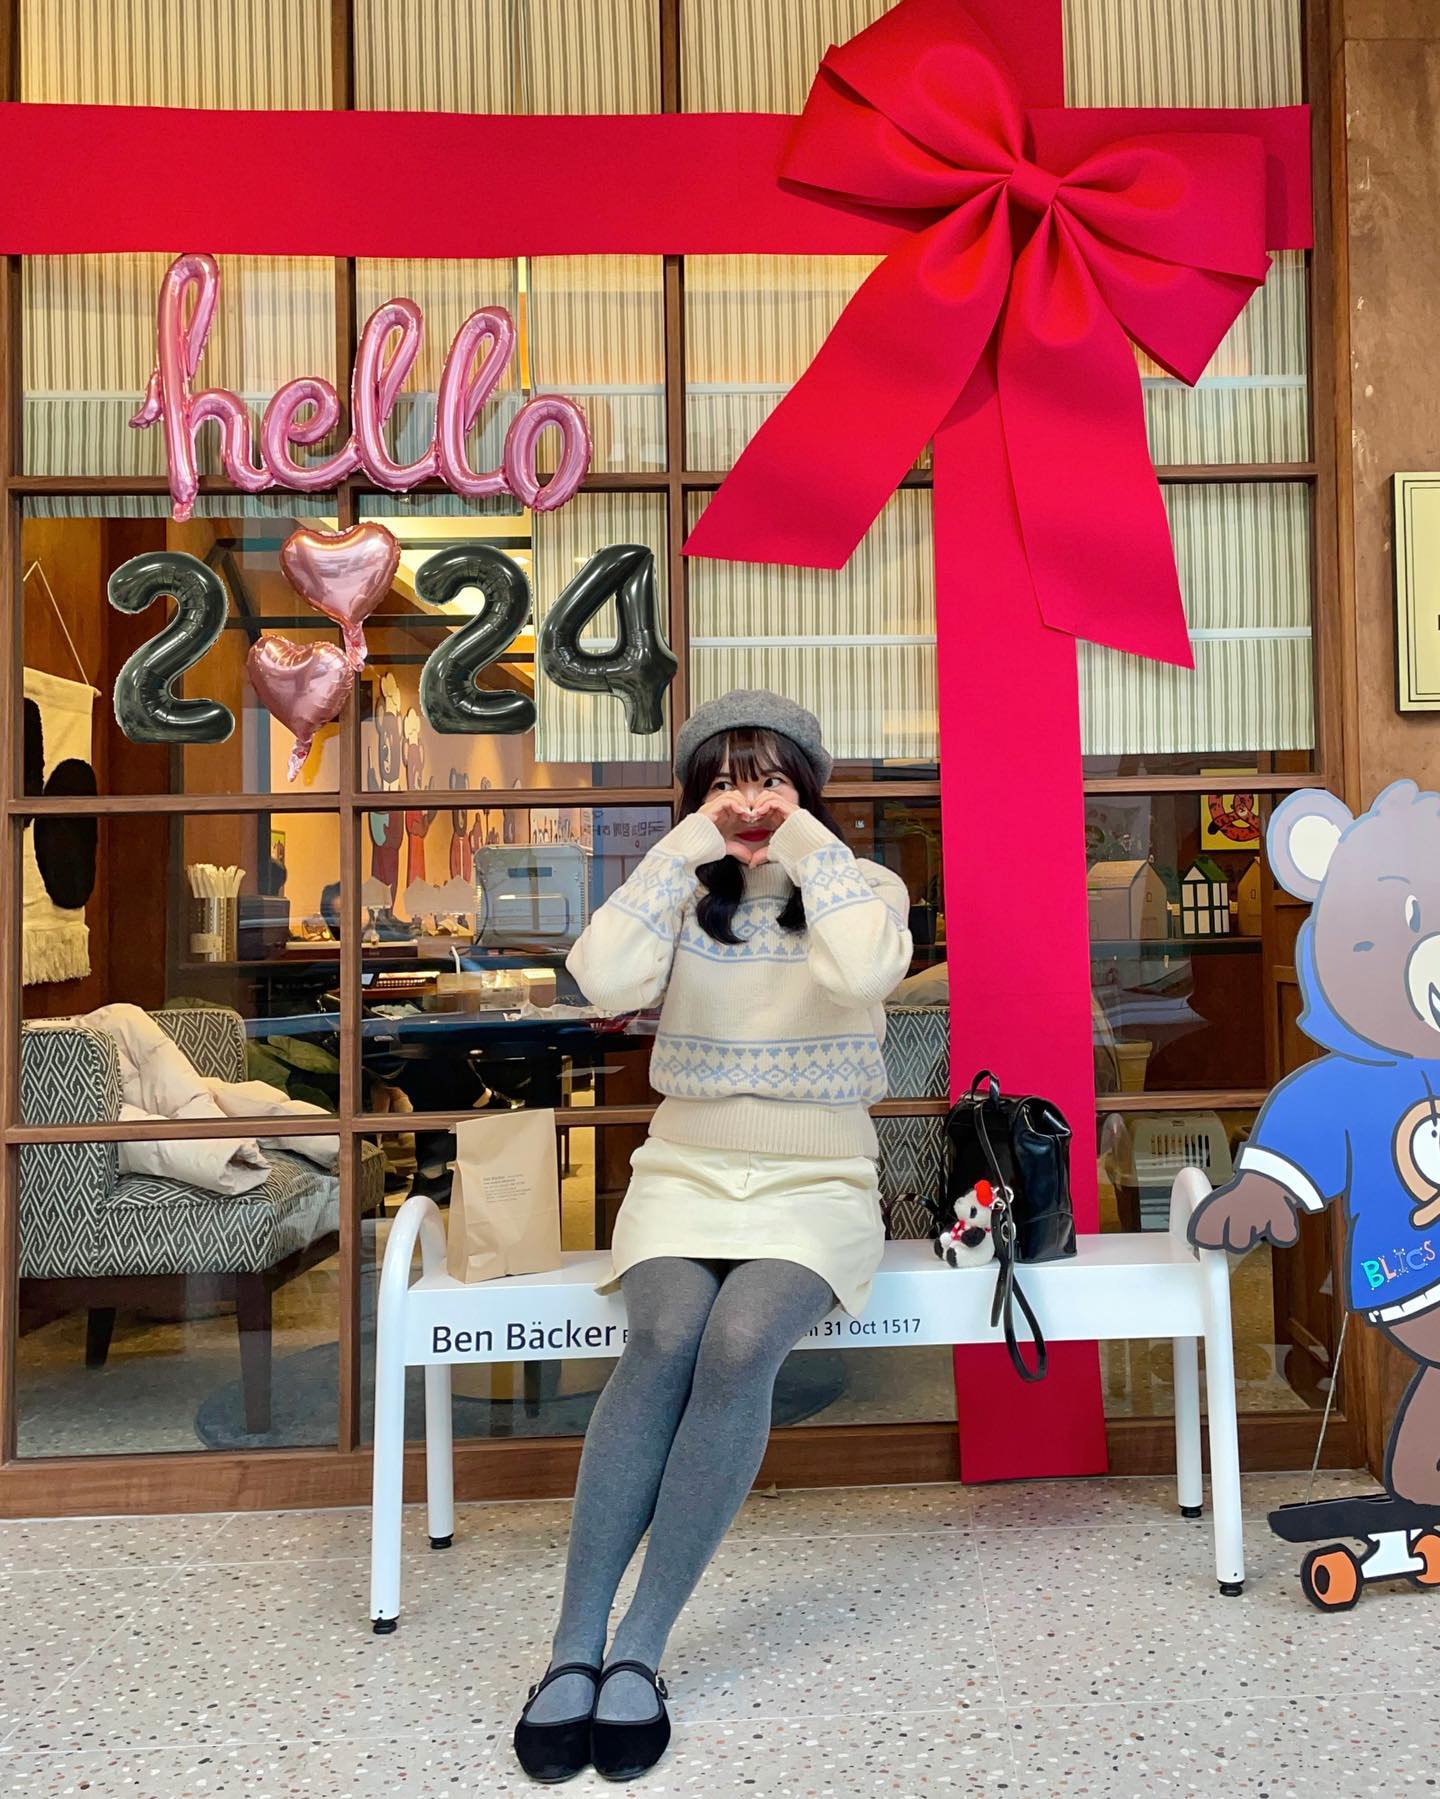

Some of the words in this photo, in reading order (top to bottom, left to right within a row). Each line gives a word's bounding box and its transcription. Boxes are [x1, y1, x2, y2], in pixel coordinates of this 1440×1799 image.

[129, 252, 593, 522] hello
[1360, 1240, 1436, 1291] BLICS
[432, 1325, 493, 1354] Ben
[506, 1319, 617, 1351] Bäcker
[823, 1320, 841, 1337] 31
[849, 1320, 877, 1336] Oct
[882, 1318, 921, 1335] 1517
